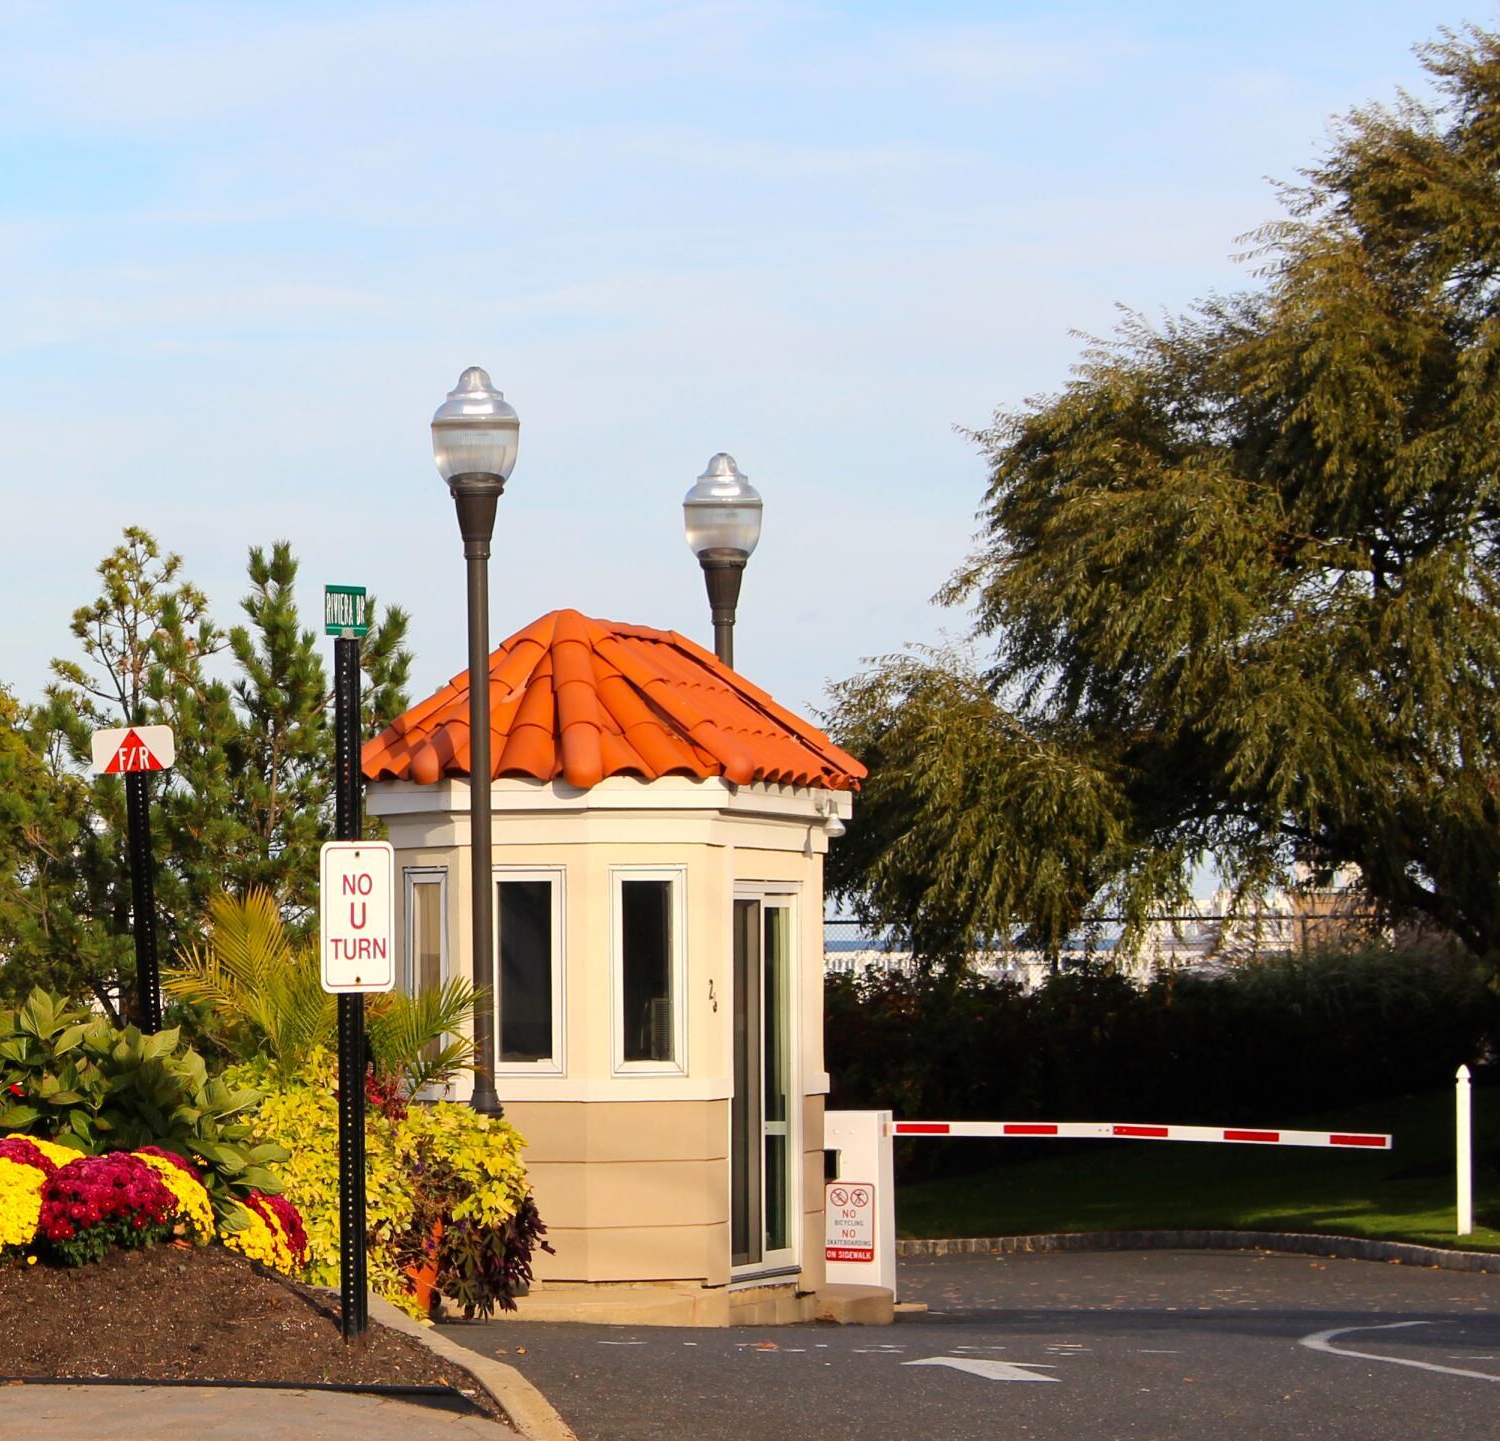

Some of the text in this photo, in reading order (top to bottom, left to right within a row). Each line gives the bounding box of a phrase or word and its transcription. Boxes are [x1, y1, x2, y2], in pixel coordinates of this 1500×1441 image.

[326, 592, 365, 626] RIVIERA DR
[118, 746, 150, 771] F/R
[342, 873, 373, 896] NO
[350, 902, 367, 930] U
[330, 937, 387, 960] TURN
[842, 1209, 856, 1218] NO
[841, 1229, 856, 1238] NO
[826, 1250, 872, 1259] ON SIDEWALK
